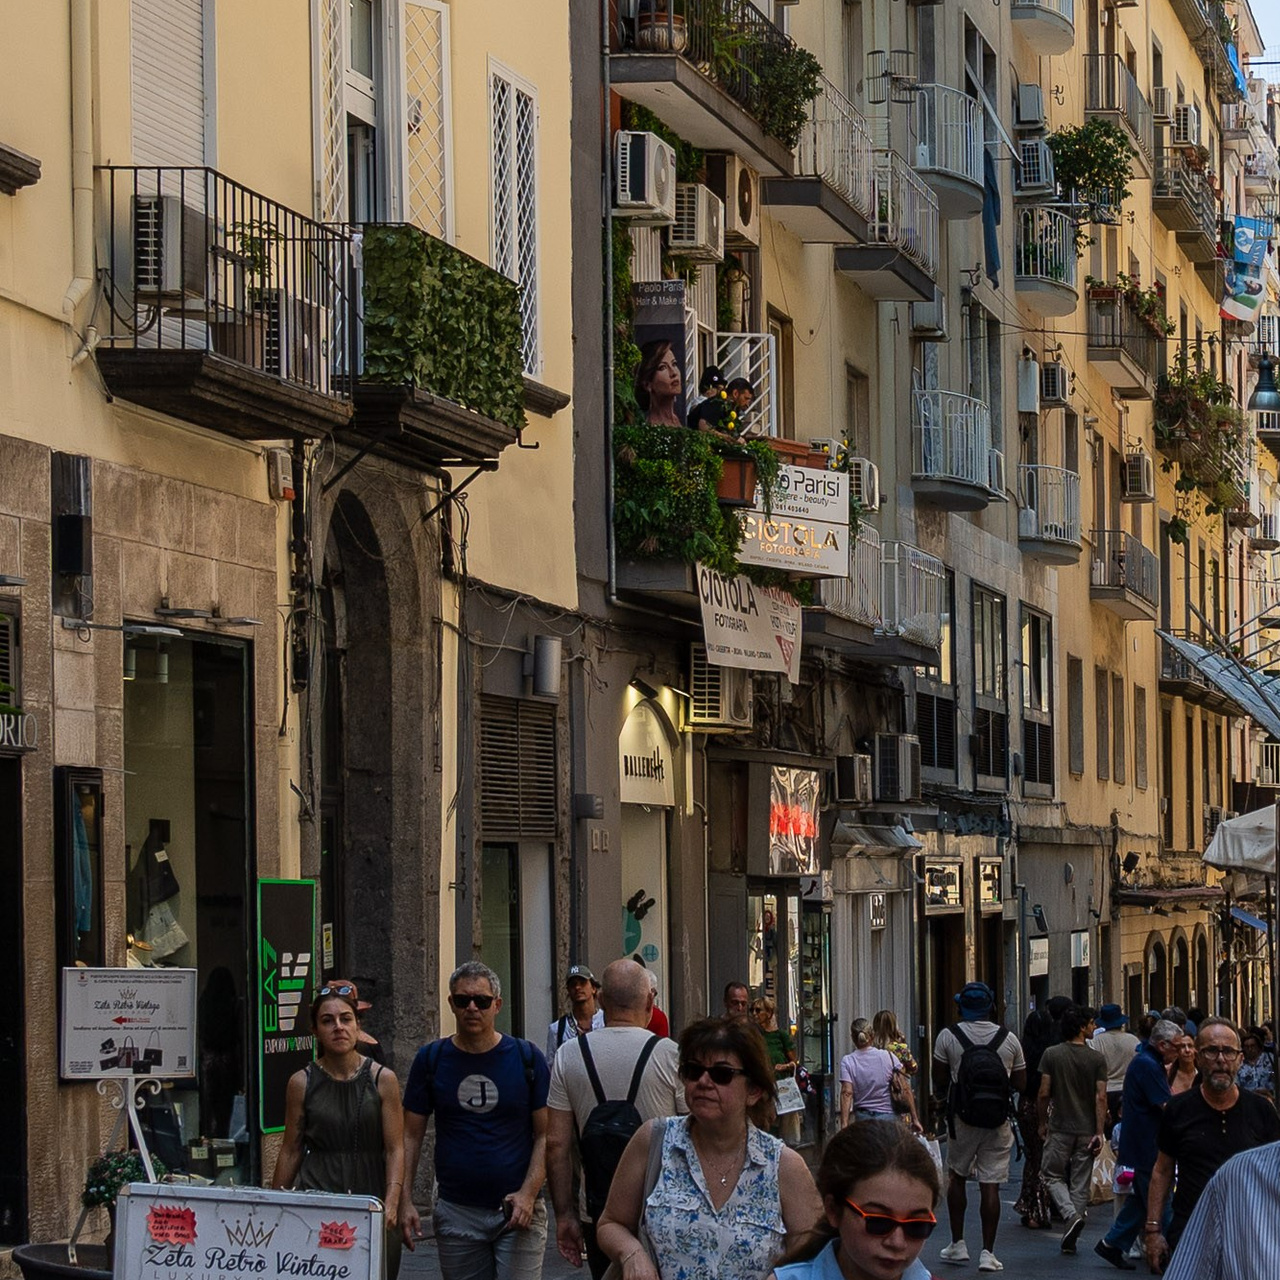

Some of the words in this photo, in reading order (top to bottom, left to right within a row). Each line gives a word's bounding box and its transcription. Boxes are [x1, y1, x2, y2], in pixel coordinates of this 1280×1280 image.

[794, 470, 840, 497] Parisi
[804, 494, 829, 507] beauty
[741, 517, 839, 551] CIOTOLA
[700, 568, 759, 617] CIOTOLA
[0, 713, 38, 748] RIO
[263, 937, 277, 1032] EA7
[264, 1037, 289, 1054] EMPORIO
[466, 1081, 490, 1108] J
[146, 1244, 196, 1268] Zeta
[204, 1247, 268, 1273] Retrò
